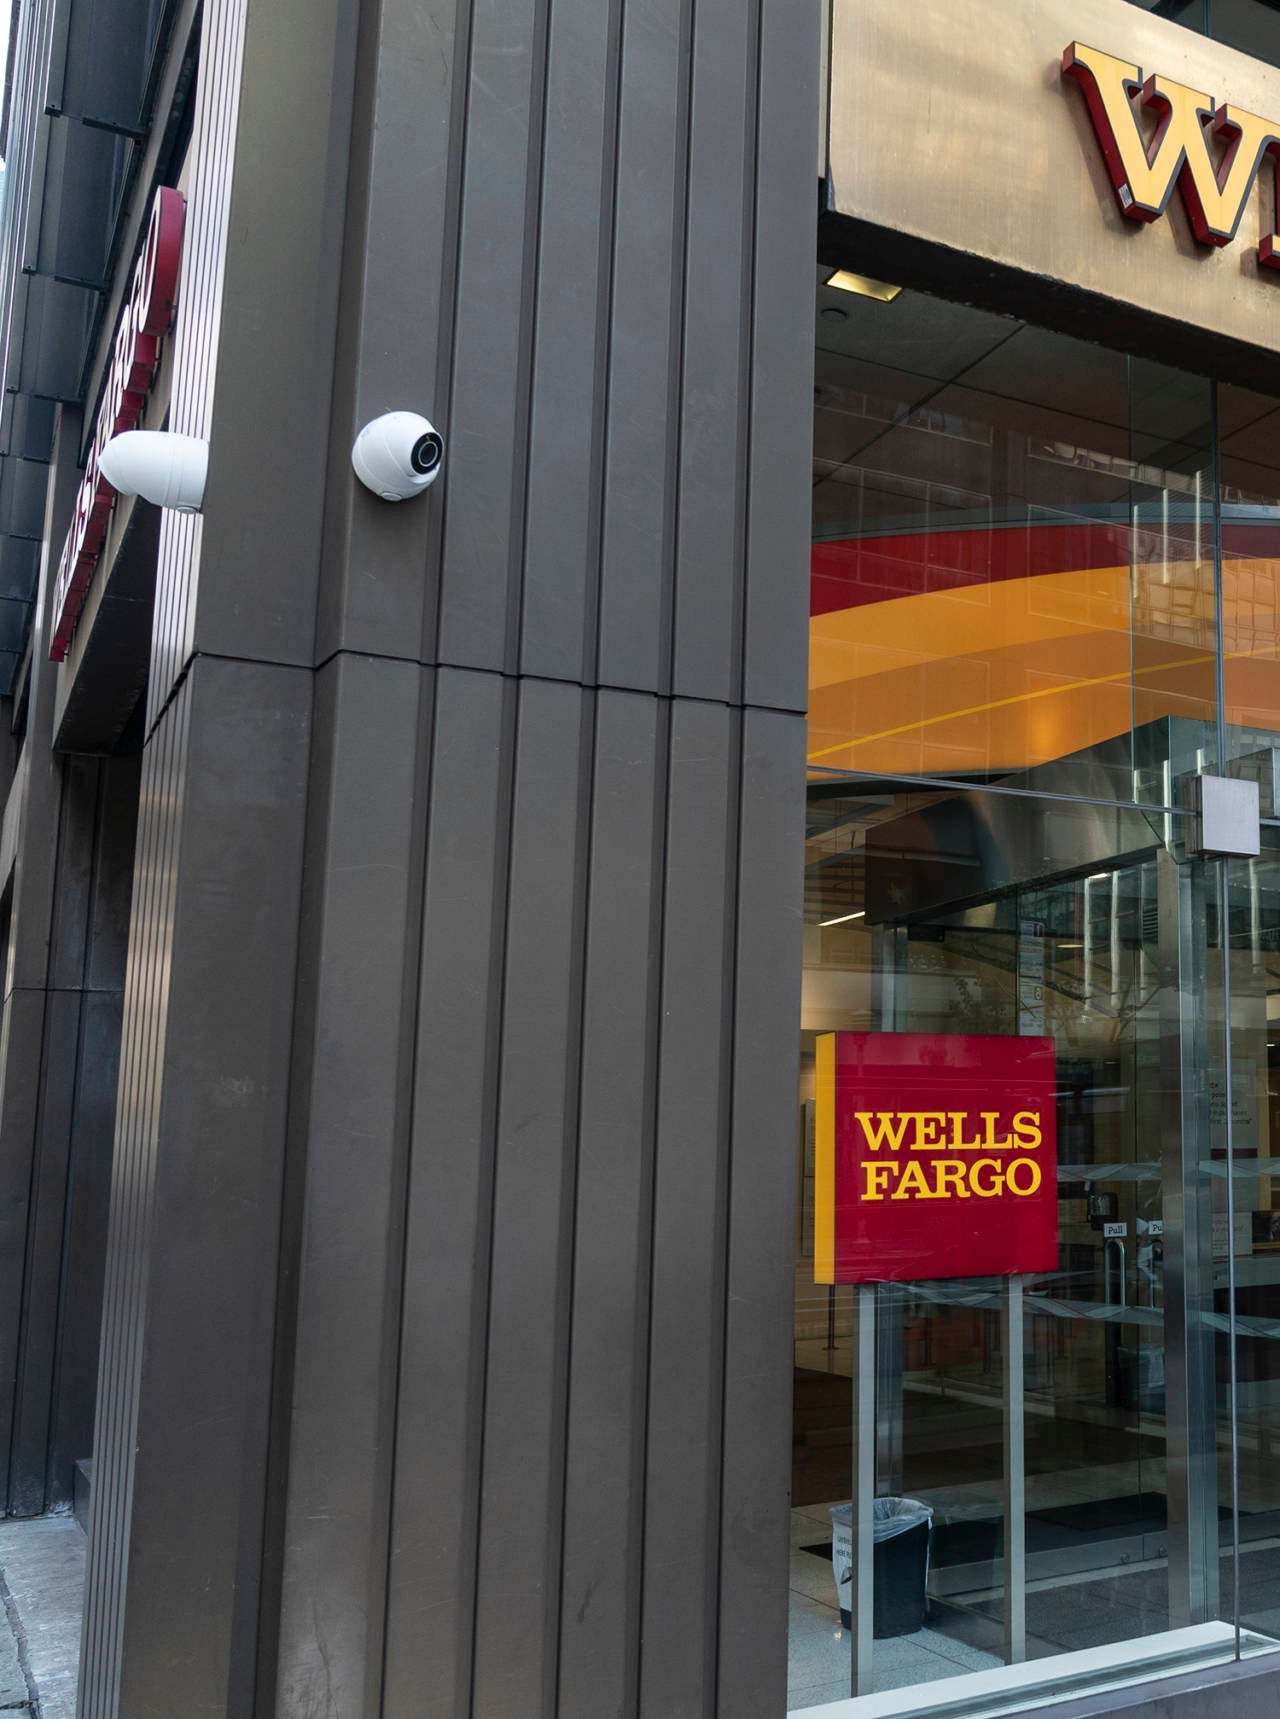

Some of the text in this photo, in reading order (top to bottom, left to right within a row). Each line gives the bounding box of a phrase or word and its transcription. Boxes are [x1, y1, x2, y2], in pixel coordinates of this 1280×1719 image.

[854, 1111, 1042, 1151] WELLS
[860, 1157, 1042, 1201] FARGO
[1108, 1225, 1123, 1235] Pull
[1153, 1224, 1162, 1232] Pu
